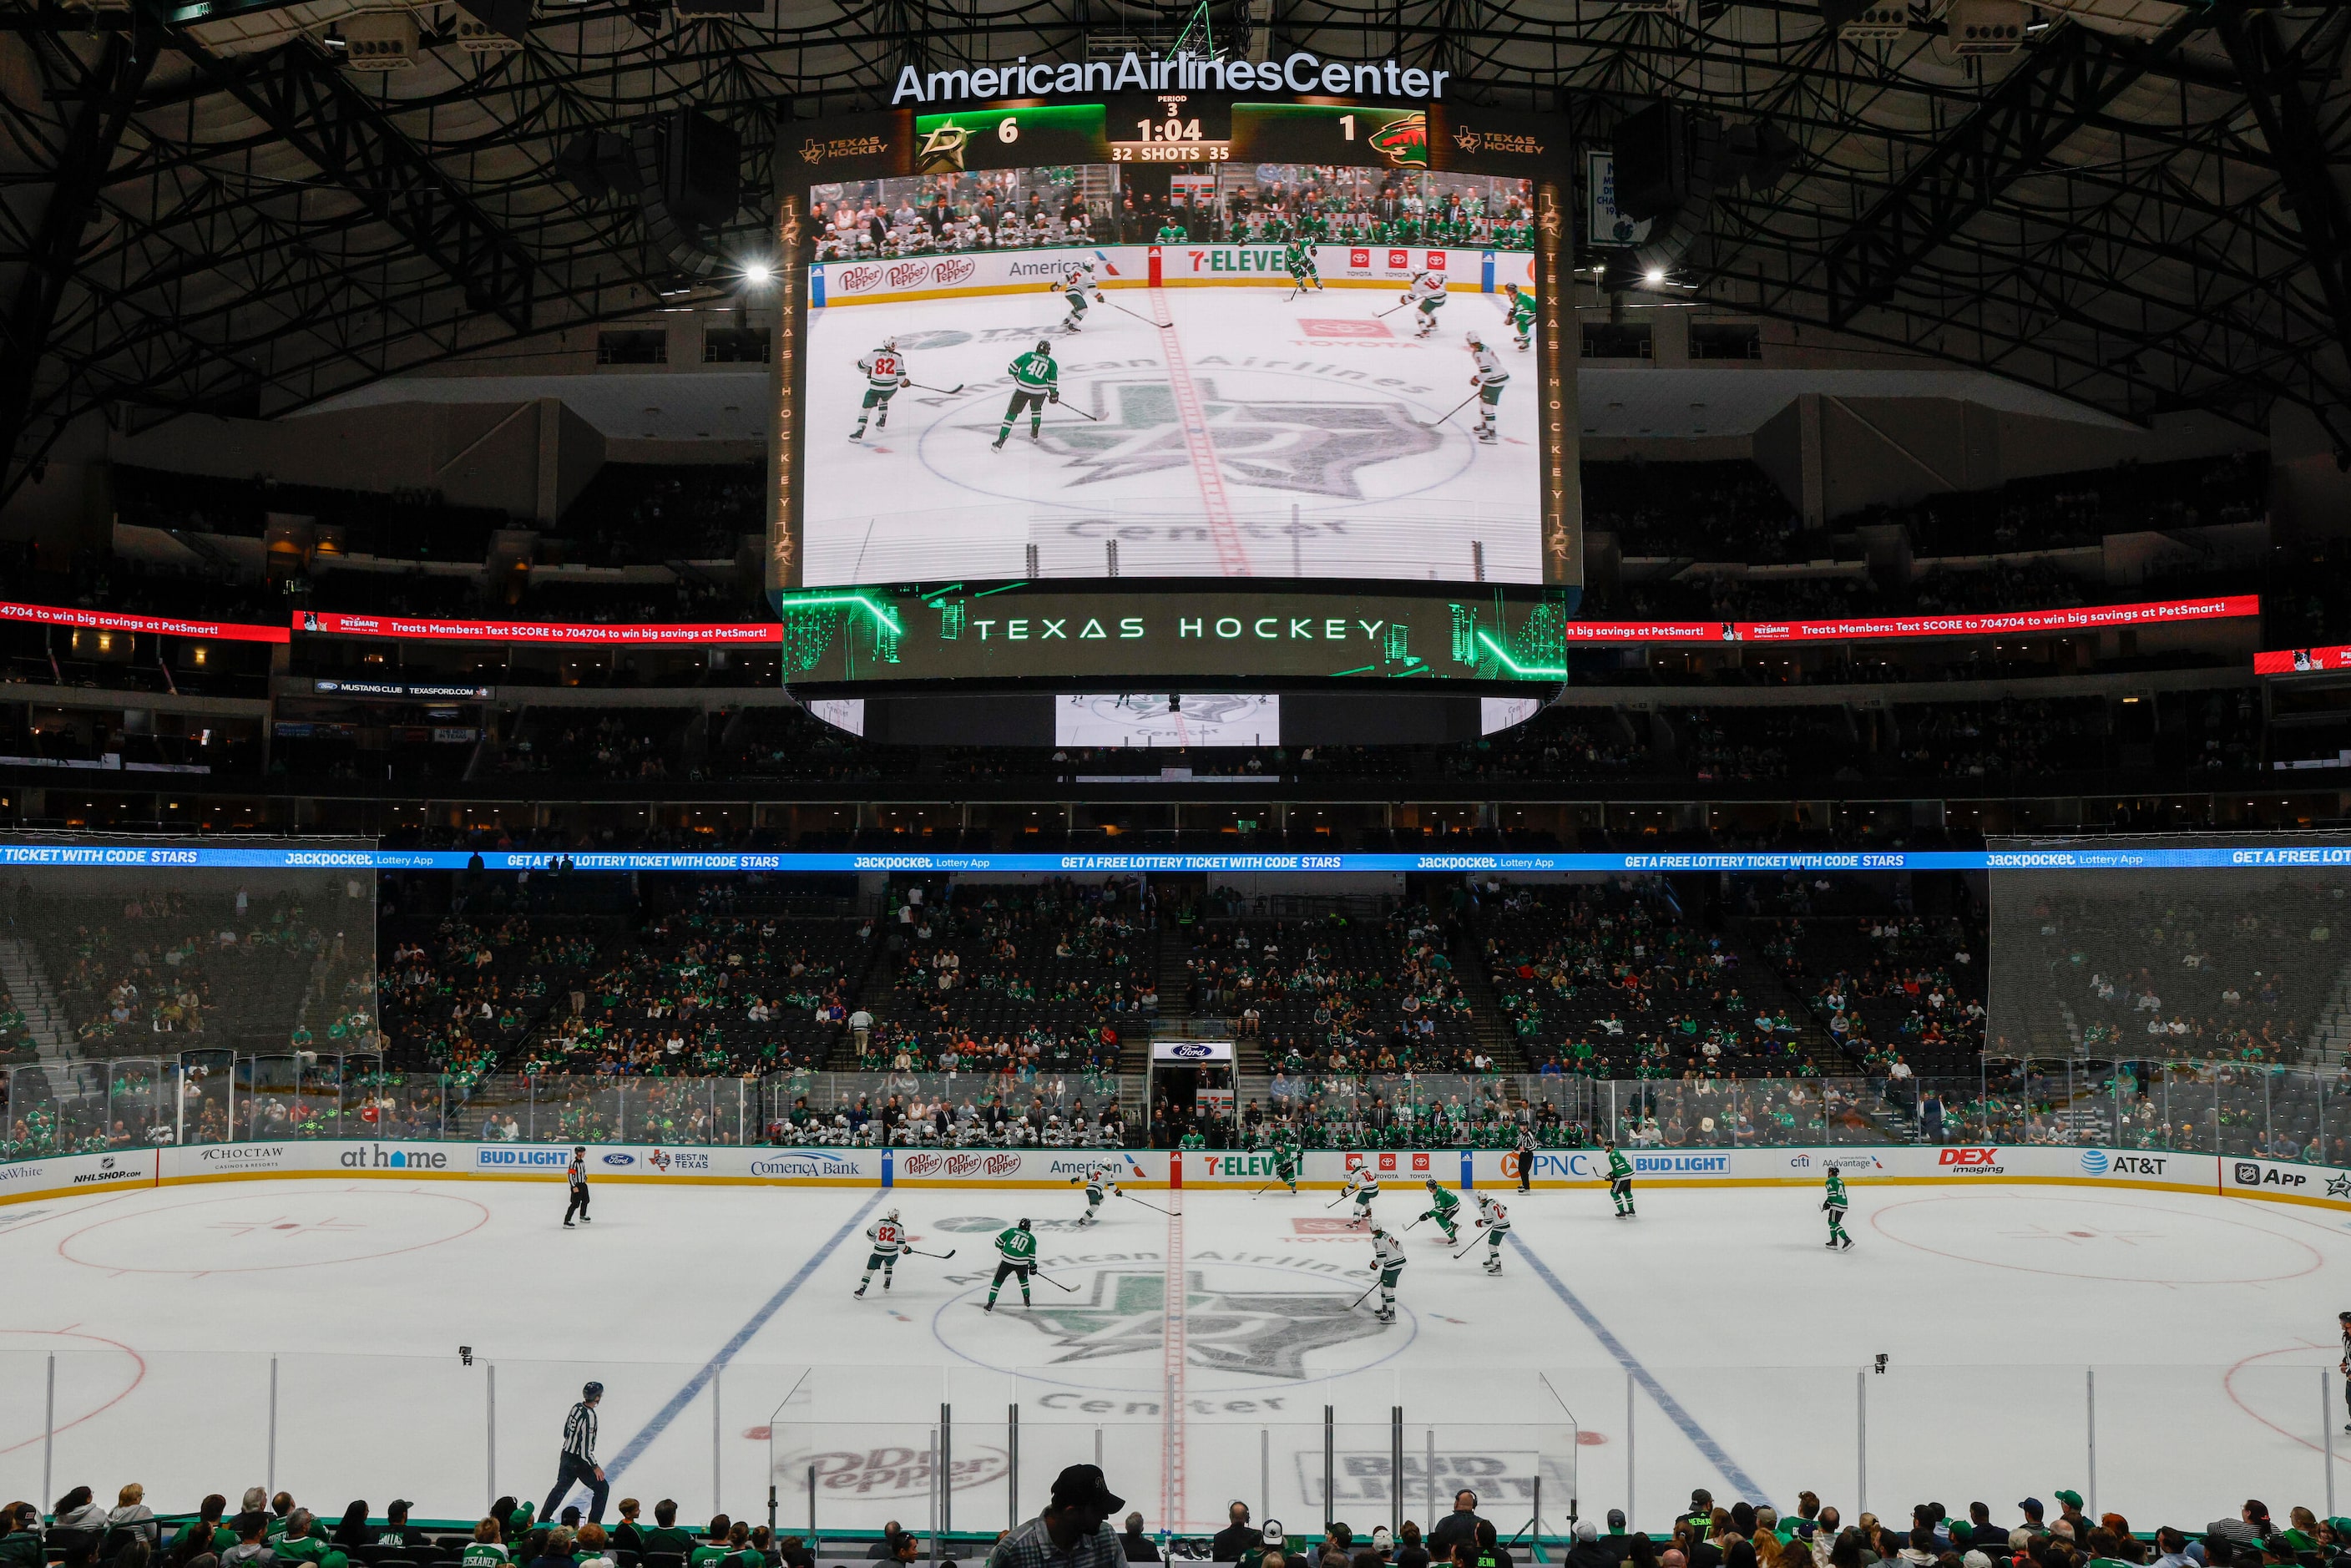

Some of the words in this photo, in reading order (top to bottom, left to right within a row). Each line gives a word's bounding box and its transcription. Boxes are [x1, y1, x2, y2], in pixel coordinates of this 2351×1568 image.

[1166, 103, 1178, 117] 3
[999, 117, 1019, 144] 6
[1137, 119, 1202, 142] 1:04
[1339, 114, 1355, 141] 1
[828, 136, 880, 149] TEXAS
[1484, 132, 1536, 144] TEXAS
[828, 144, 888, 158] HOCKEY
[1112, 148, 1132, 161] 32
[1141, 148, 1200, 160] SHOTS
[1209, 147, 1229, 160] 35
[1484, 142, 1545, 154] HOCKEY
[1546, 253, 1560, 351] TEXAS
[782, 263, 794, 359] TEXAS
[875, 357, 896, 375] 82
[1026, 360, 1049, 379] 40
[1196, 355, 1434, 394] Airlines
[1550, 378, 1564, 499] HOCKEY
[779, 387, 792, 507] HOCKEY
[37, 609, 50, 620] to
[53, 611, 74, 623] win
[77, 612, 96, 626] big
[99, 615, 144, 630] savings
[147, 620, 159, 631] at
[162, 621, 218, 635] PetSmart!
[1802, 625, 1837, 635] Treats
[1838, 621, 1893, 634] Members:
[1896, 621, 1921, 631] Text
[1923, 620, 1962, 631] SCORE
[1965, 619, 1978, 630] to
[1979, 616, 2025, 630] 704704
[2028, 615, 2041, 625] to
[2043, 614, 2065, 625] win
[2067, 611, 2088, 625] big
[2091, 609, 2139, 624] savings
[2141, 609, 2156, 619] at
[2158, 602, 2226, 616] PetSmart!
[392, 622, 427, 634] Treats
[430, 624, 483, 635] Members:
[486, 625, 508, 635] Text
[511, 626, 549, 637] SCORE
[552, 627, 564, 637] to
[566, 628, 606, 639] 704704
[609, 629, 620, 639] to
[622, 629, 640, 639] win
[642, 629, 658, 642] big
[660, 629, 700, 642] savings
[702, 630, 713, 639] at
[715, 629, 767, 638] PetSmart!
[973, 617, 1145, 640] TEXAS
[1180, 617, 1383, 640] HOCKEY
[1577, 626, 1594, 640] big
[1595, 627, 1636, 640] savings
[1638, 627, 1650, 636] at
[1652, 626, 1705, 636] PetSmart!
[341, 684, 381, 692] MUSTANG
[382, 685, 403, 694] CLUB
[409, 687, 474, 695] TEXASFORD.COM
[5, 848, 60, 862] TICKET
[62, 849, 104, 862] WITH
[105, 850, 146, 862] CODE
[150, 850, 198, 863] STARS
[377, 856, 411, 866] Lottery
[413, 856, 433, 866] App
[508, 855, 533, 866] GET
[533, 856, 542, 866] A
[576, 856, 627, 867] LOTTERY
[629, 856, 670, 867] TICKET
[671, 856, 703, 867] WITH
[705, 856, 737, 867] CODE
[741, 856, 779, 867] STARS
[1061, 857, 1085, 868] GET
[1085, 857, 1095, 868] A
[1096, 857, 1128, 868] FREE
[1130, 857, 1184, 868] LOTTERY
[1185, 857, 1229, 868] TICKET
[1230, 857, 1263, 868] WITH
[1264, 857, 1298, 868] CODE
[1301, 857, 1342, 868] STARS
[1625, 856, 1649, 867] GET
[1649, 856, 1658, 867] A
[1659, 856, 1691, 867] FREE
[1692, 856, 1745, 867] LOTTERY
[1747, 856, 1789, 867] TICKET
[1790, 856, 1822, 867] WITH
[1824, 856, 1858, 867] CODE
[1863, 855, 1904, 867] STARS
[2080, 855, 2117, 866] Lottery
[2121, 854, 2143, 866] App
[2232, 851, 2263, 864] GET
[2264, 851, 2276, 863] A
[2278, 850, 2319, 863] FREE
[936, 858, 968, 869] Lottery
[970, 858, 990, 869] App
[1500, 858, 1532, 869] Lottery
[1534, 858, 1555, 869] App
[1179, 1044, 1206, 1056] Ford
[210, 1147, 284, 1160] CHOCTAW
[341, 1147, 367, 1169] at
[480, 1151, 516, 1166] BUD
[518, 1151, 569, 1166] LIGHT
[609, 1154, 629, 1166] Ford
[918, 1152, 932, 1164] Dr
[958, 1152, 970, 1164] Dr
[996, 1152, 1009, 1164] Dr
[1938, 1148, 1998, 1166] DEX
[675, 1161, 709, 1169] TEXAS
[823, 1162, 860, 1176] Bank
[906, 1158, 940, 1176] Pepper
[945, 1158, 979, 1176] Pepper
[984, 1158, 1019, 1176] Pepper
[1533, 1155, 1588, 1176] PNC
[1636, 1158, 1671, 1171] BUD
[1675, 1157, 1727, 1171] LIGHT
[1791, 1157, 1809, 1167] citi
[1823, 1159, 1870, 1169] AAdvantage
[2113, 1156, 2166, 1176] AT&T
[73, 1171, 141, 1183] NHLSHOP.COM
[1361, 1171, 1374, 1183] 16
[1953, 1166, 2004, 1174] imaging
[878, 1227, 896, 1242] 82
[1009, 1235, 1029, 1252] 40
[1037, 1393, 1287, 1417] Center
[1342, 1456, 1507, 1476] BUD
